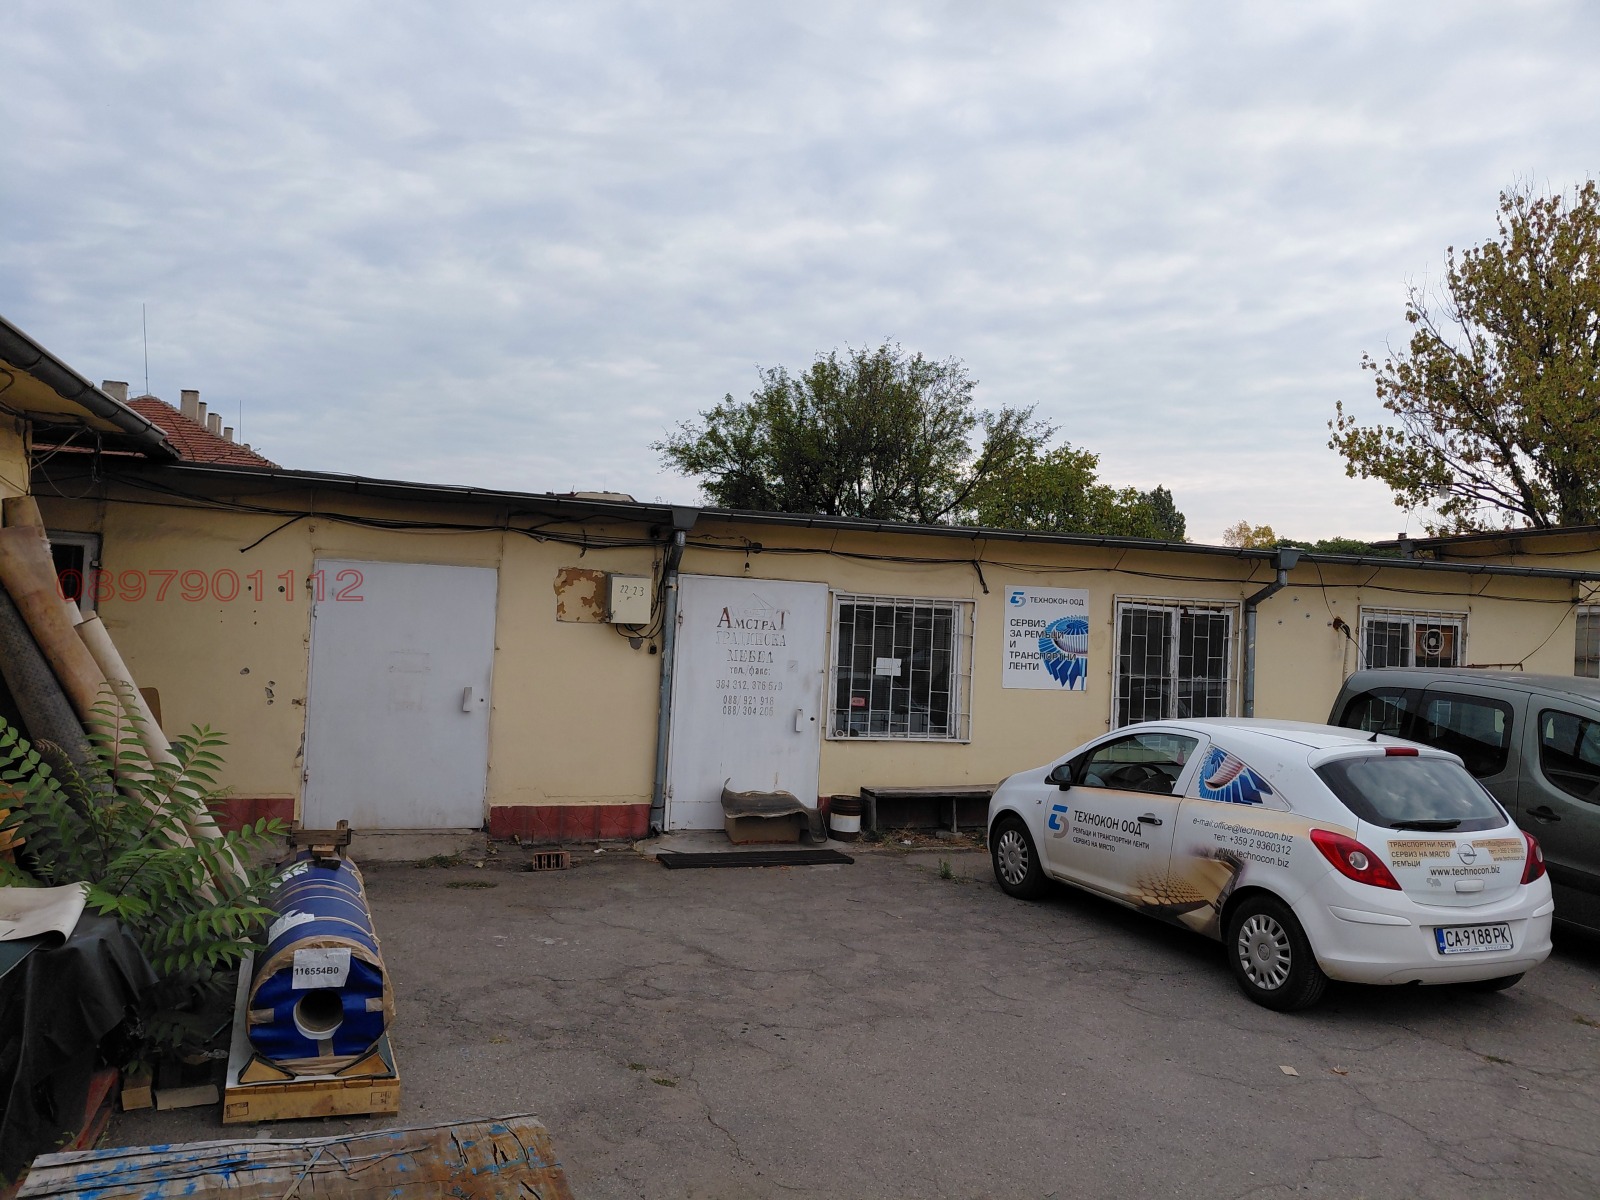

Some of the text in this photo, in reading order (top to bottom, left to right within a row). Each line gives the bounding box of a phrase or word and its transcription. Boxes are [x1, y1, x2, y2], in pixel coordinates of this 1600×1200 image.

[1030, 596, 1067, 605] ТЕХНОКОН
[1010, 619, 1046, 628] СЕРВИЗ
[1025, 630, 1064, 640] РЕМЪЦИ
[1010, 640, 1016, 648] И
[1009, 651, 1076, 660] ТРАНСПОРТНИ
[1009, 662, 1039, 670] ЛЕНТИ
[1074, 810, 1141, 837] ТЕХНОКОН ООД
[1193, 818, 1293, 842] e-mail:office@technocon.biz
[1073, 827, 1091, 837] РЕМЪЦИ
[1097, 831, 1131, 845] ТРАНСПОРТНИ
[1133, 839, 1149, 850] ЛЕНТИ
[1073, 837, 1090, 846] СЕРВИЗ
[1099, 842, 1115, 852] МЯСТО
[1230, 836, 1247, 846] +359
[1249, 839, 1254, 847] 2
[1256, 840, 1292, 855] 9360312
[1218, 846, 1290, 868] www.technocon.biz
[1430, 866, 1500, 876] www.technocon.biz
[295, 966, 339, 975] 116554B0
